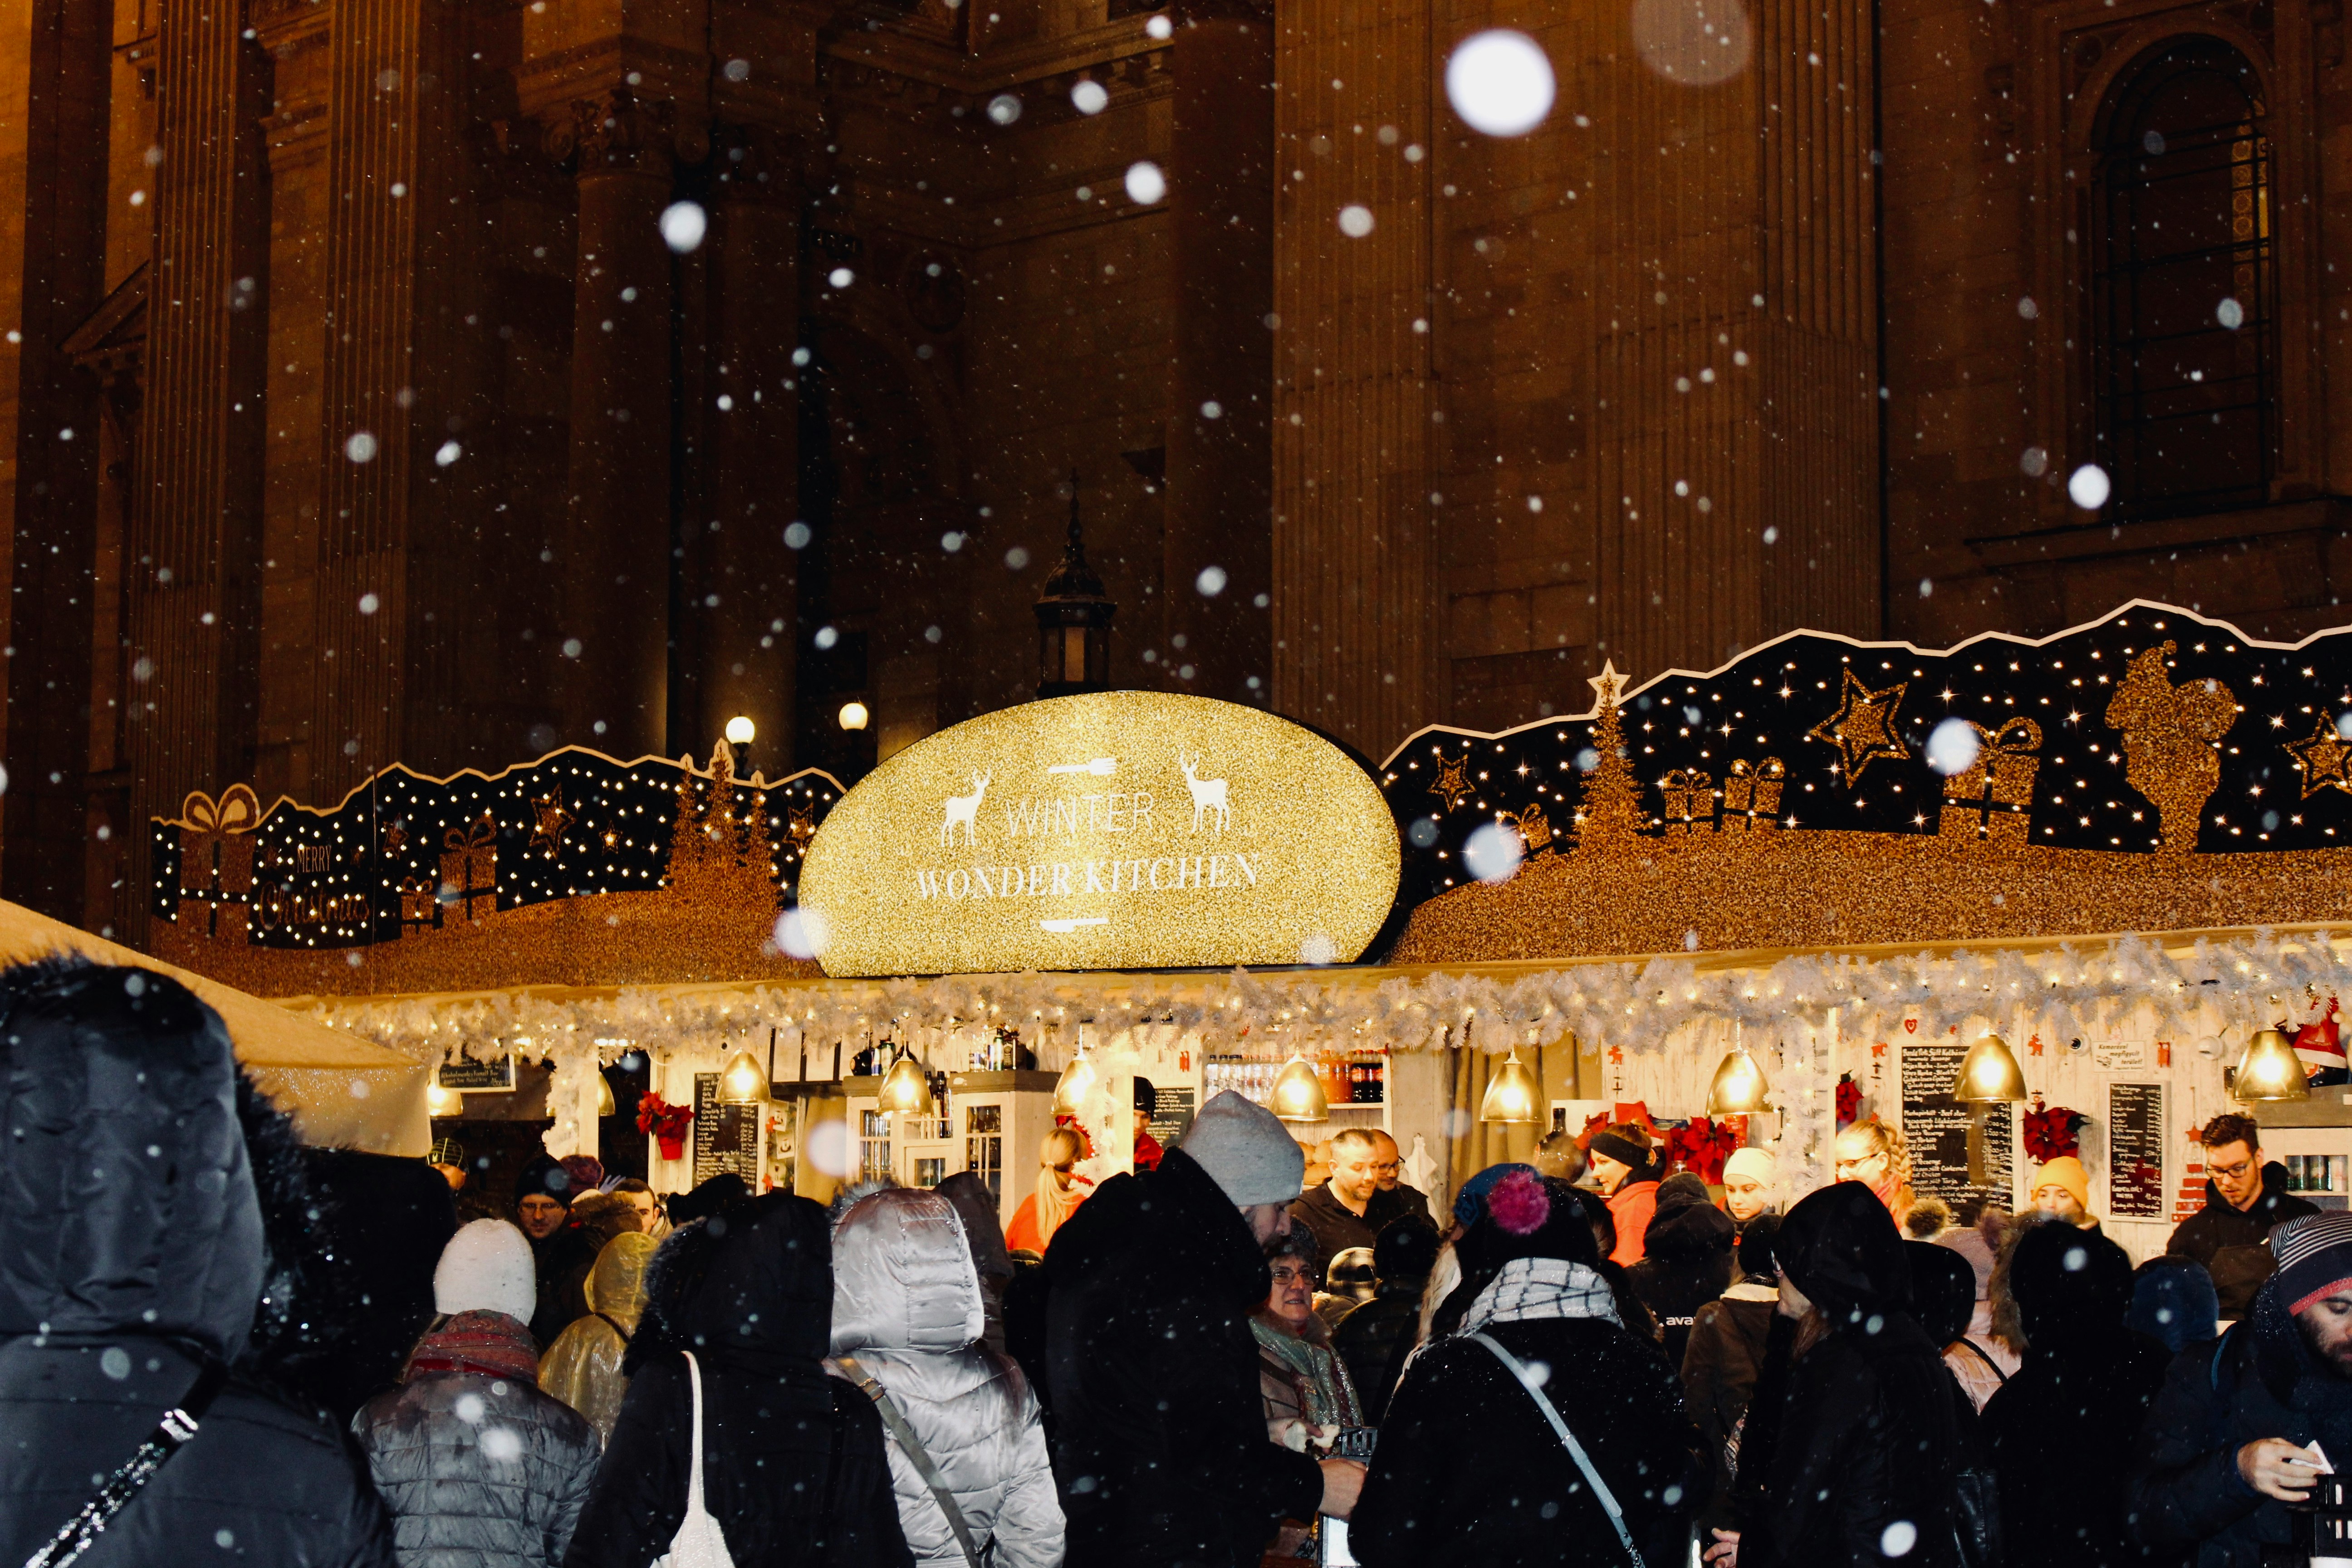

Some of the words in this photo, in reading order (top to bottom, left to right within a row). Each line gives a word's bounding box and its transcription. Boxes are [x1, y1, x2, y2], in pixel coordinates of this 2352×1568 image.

[1006, 792, 1153, 838] WINTER
[297, 845, 332, 873] MERRY
[917, 863, 1072, 900] WONDER
[1084, 853, 1261, 893] KITCHEN
[259, 881, 370, 931] Christmas
[1666, 1317, 1695, 1326] ava
